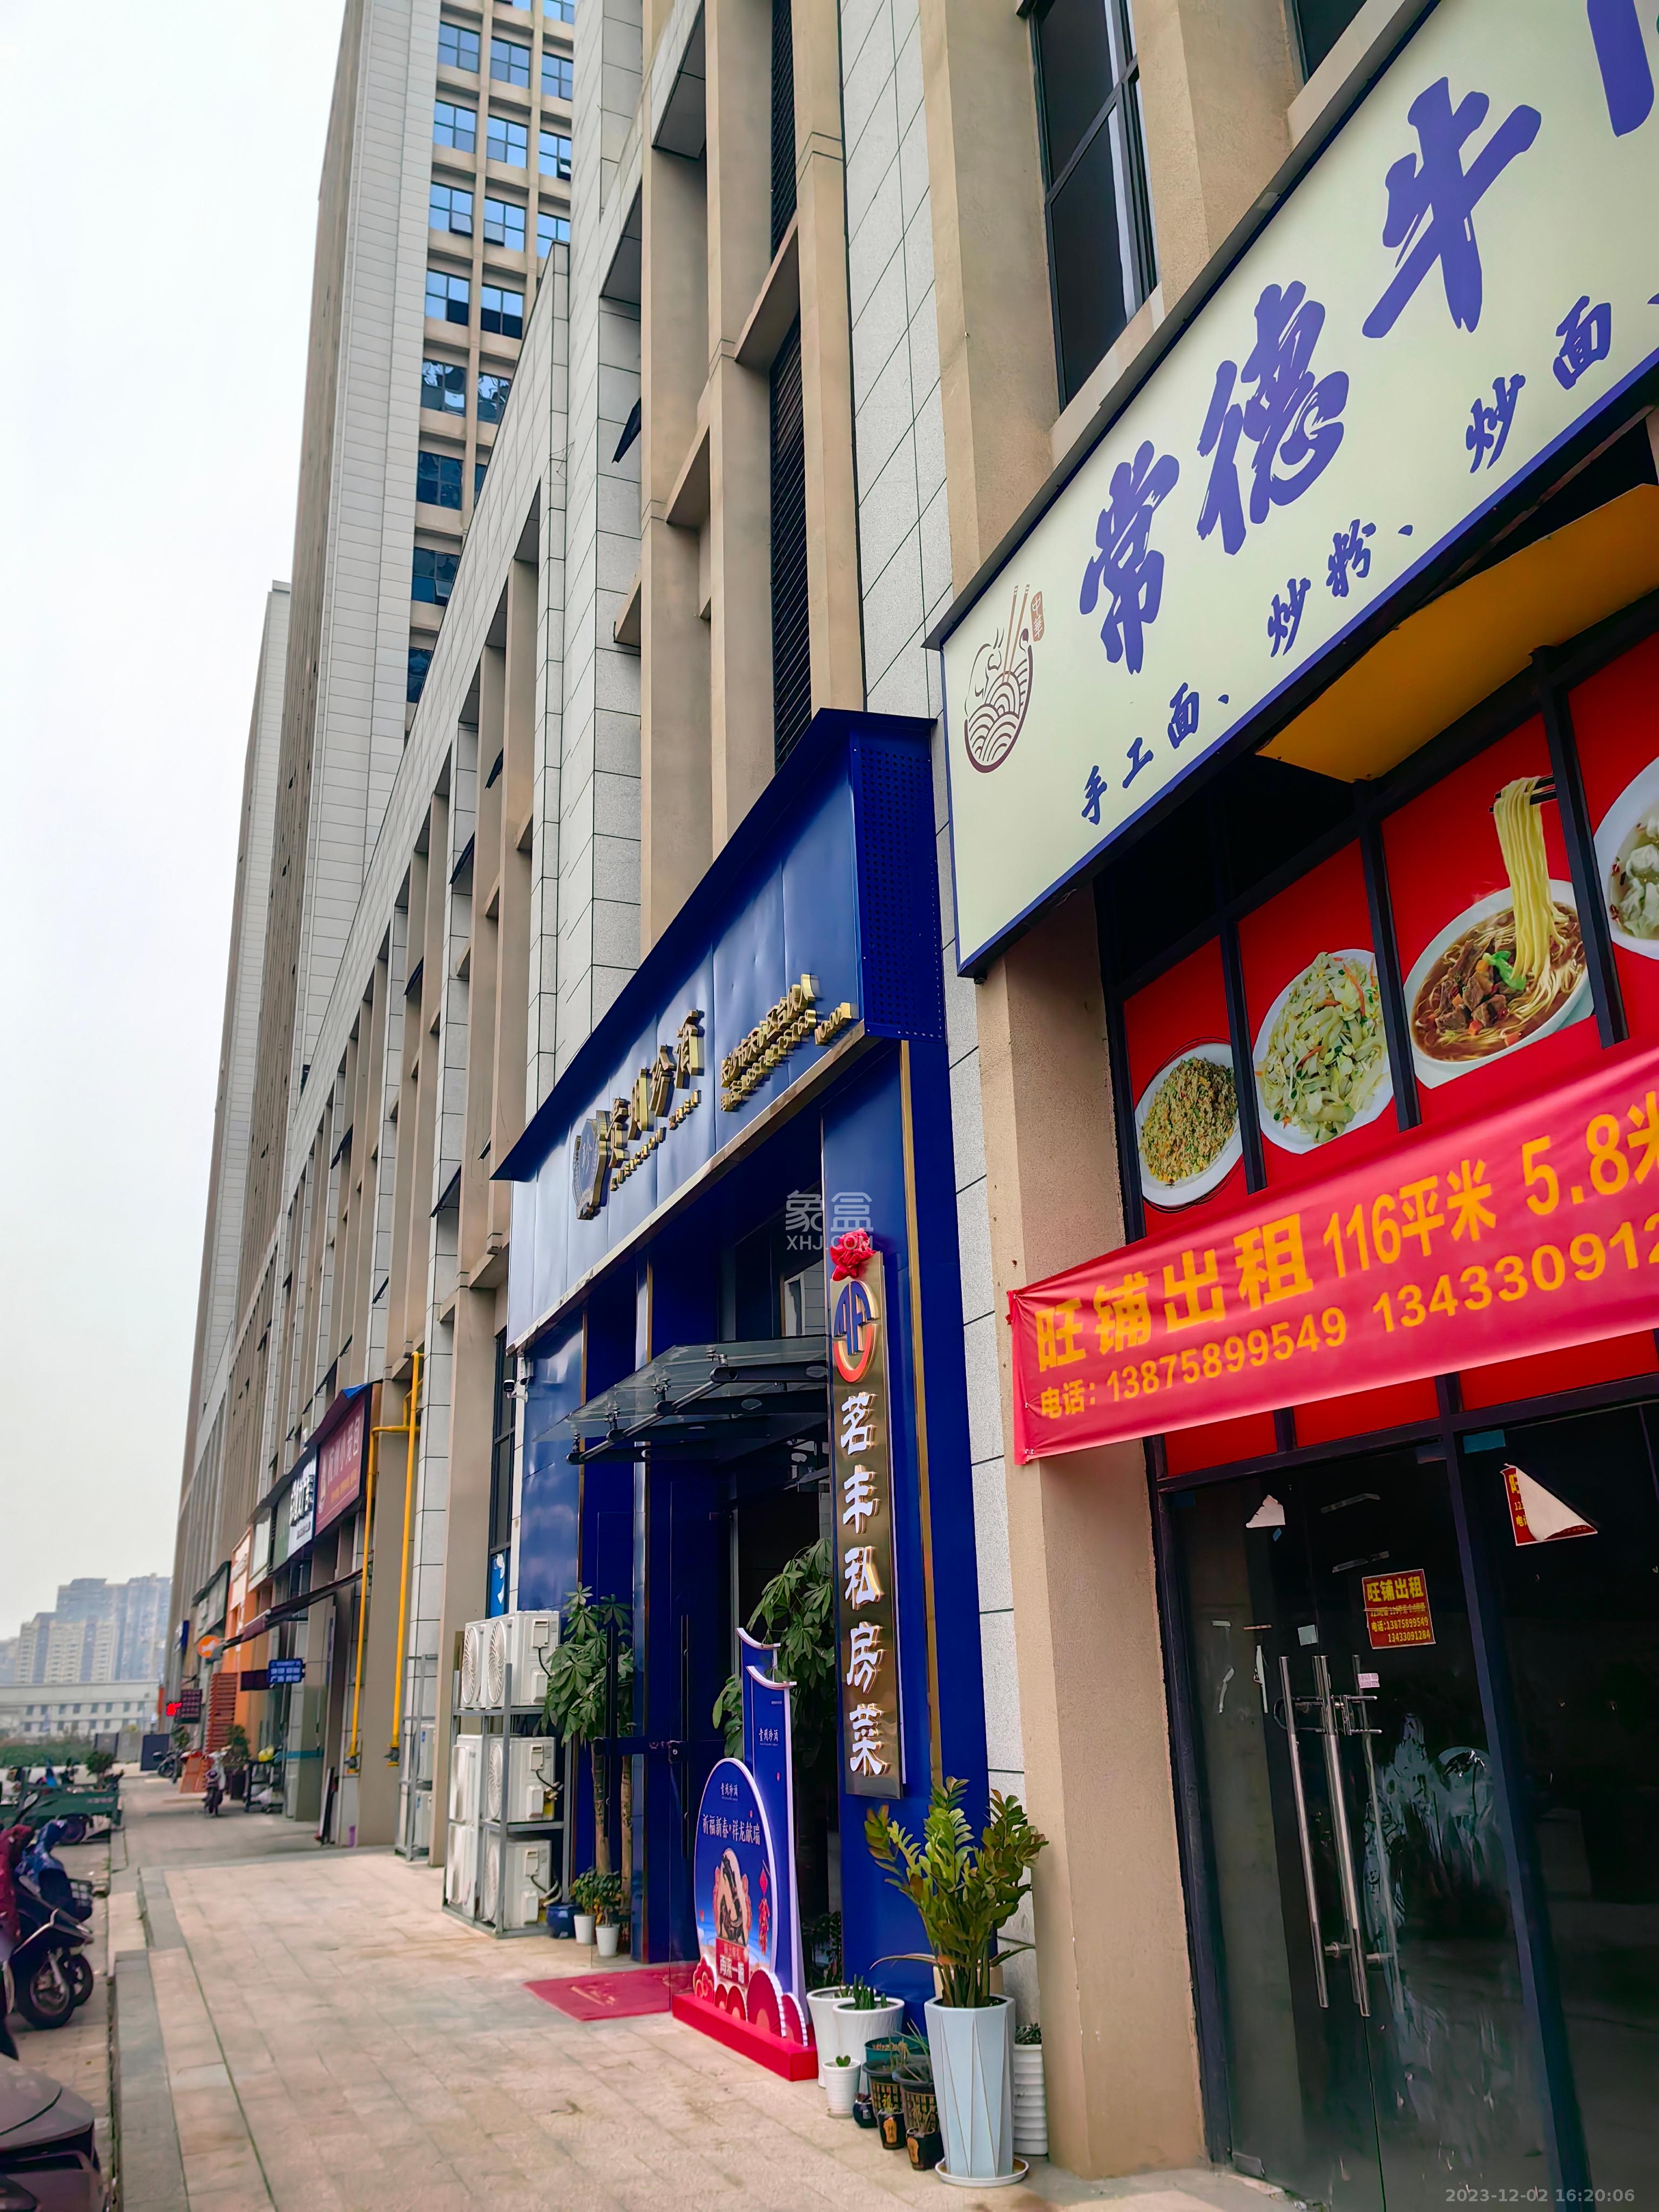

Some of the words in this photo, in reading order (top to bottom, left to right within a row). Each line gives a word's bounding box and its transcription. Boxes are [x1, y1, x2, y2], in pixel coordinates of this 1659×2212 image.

[1080, 0, 1654, 675] 常德牛
[1035, 1214, 1314, 1372] 旺铺出租
[1323, 1159, 1496, 1278] 116平米
[1366, 1576, 1424, 1602] 旺铺出租
[1388, 1629, 1431, 1643] 13433091284
